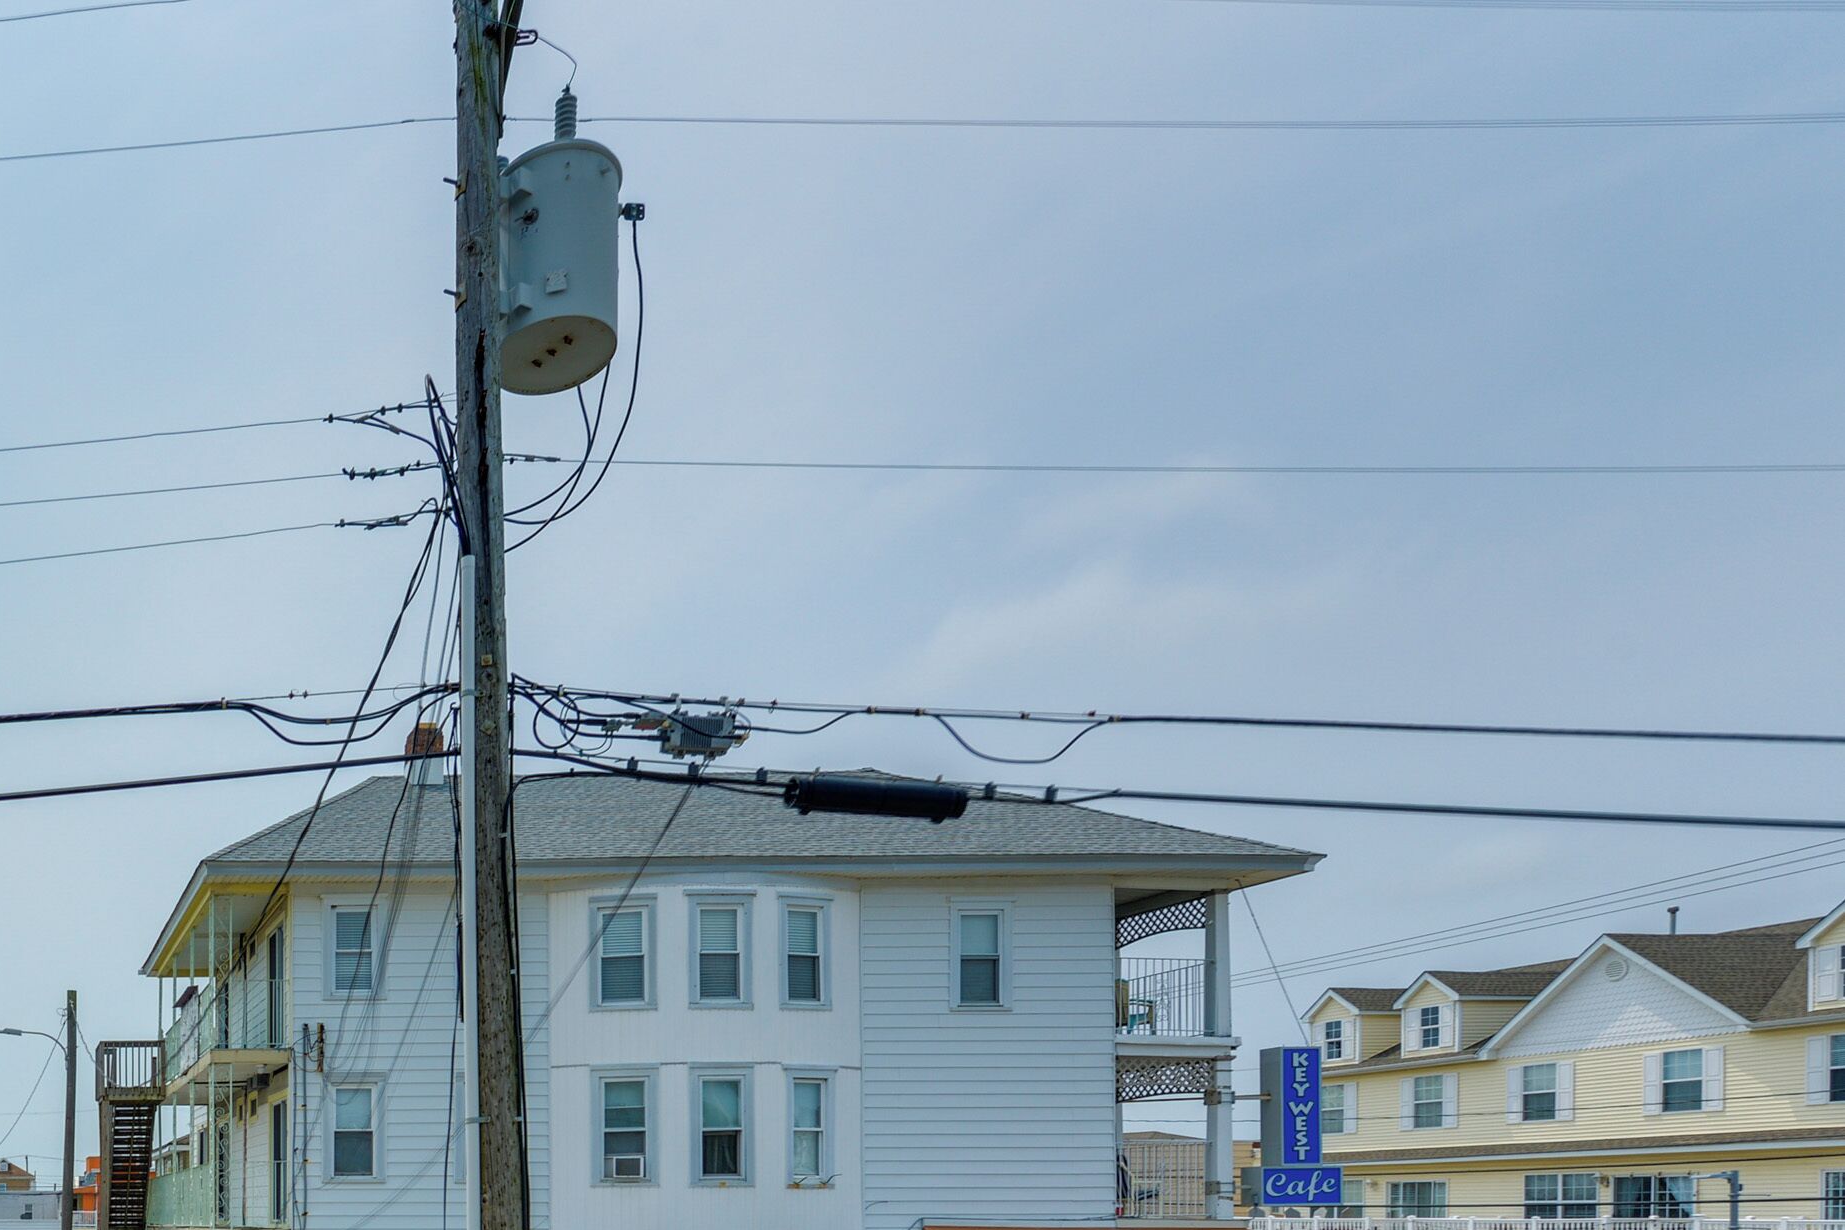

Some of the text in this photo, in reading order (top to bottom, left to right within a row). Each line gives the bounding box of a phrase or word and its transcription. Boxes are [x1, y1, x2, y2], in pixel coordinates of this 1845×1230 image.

[1288, 1052, 1314, 1161] KEY WEST
[1265, 1170, 1338, 1202] Cafe
